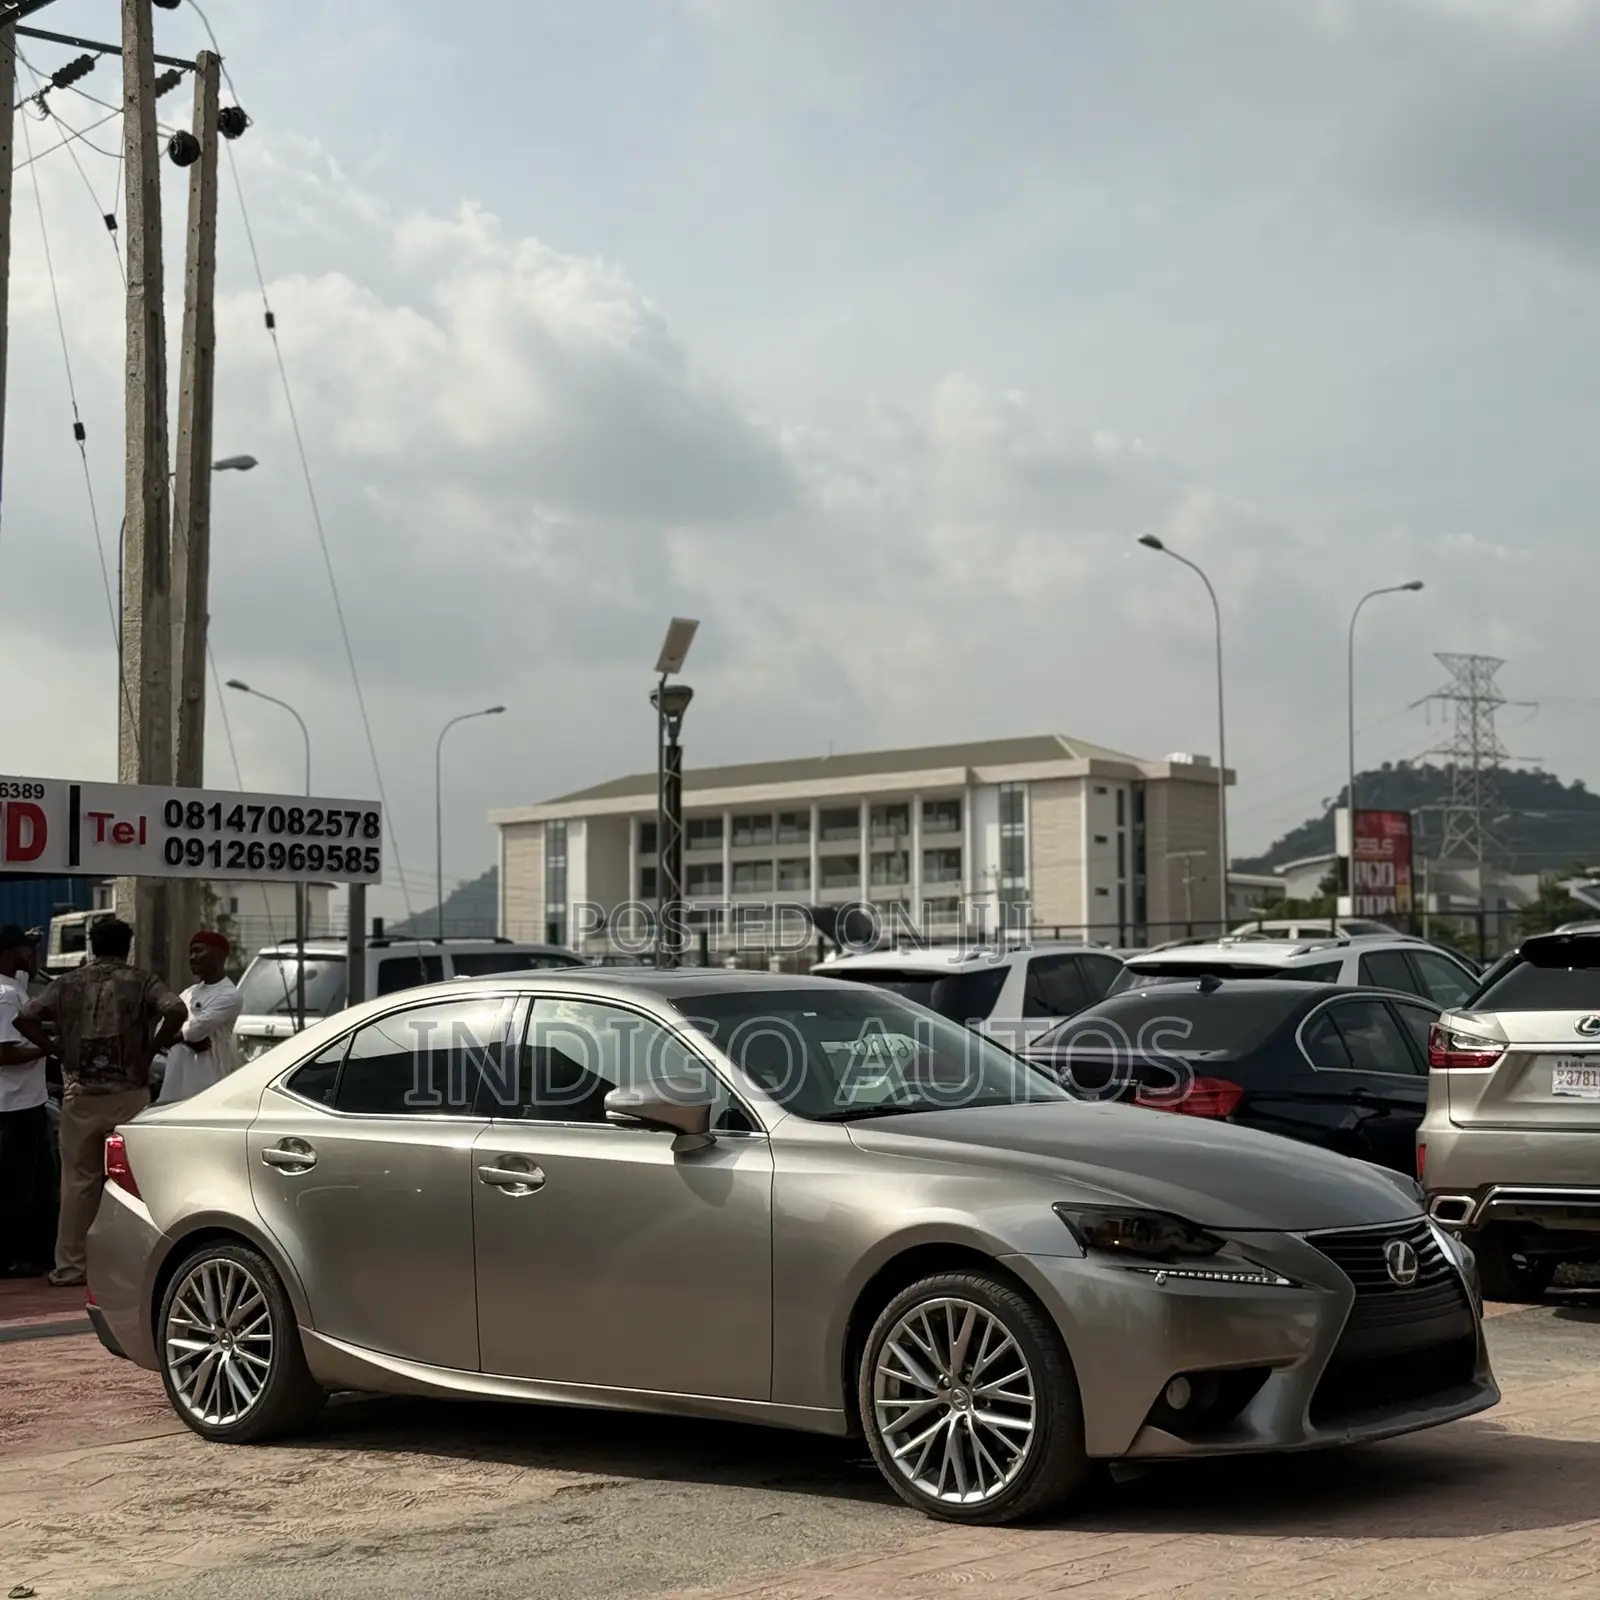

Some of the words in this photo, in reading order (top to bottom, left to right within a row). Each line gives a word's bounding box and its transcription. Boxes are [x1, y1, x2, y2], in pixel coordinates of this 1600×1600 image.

[88, 811, 147, 846] Tel
[164, 799, 381, 839] 08147082578
[164, 836, 381, 874] 09126969585
